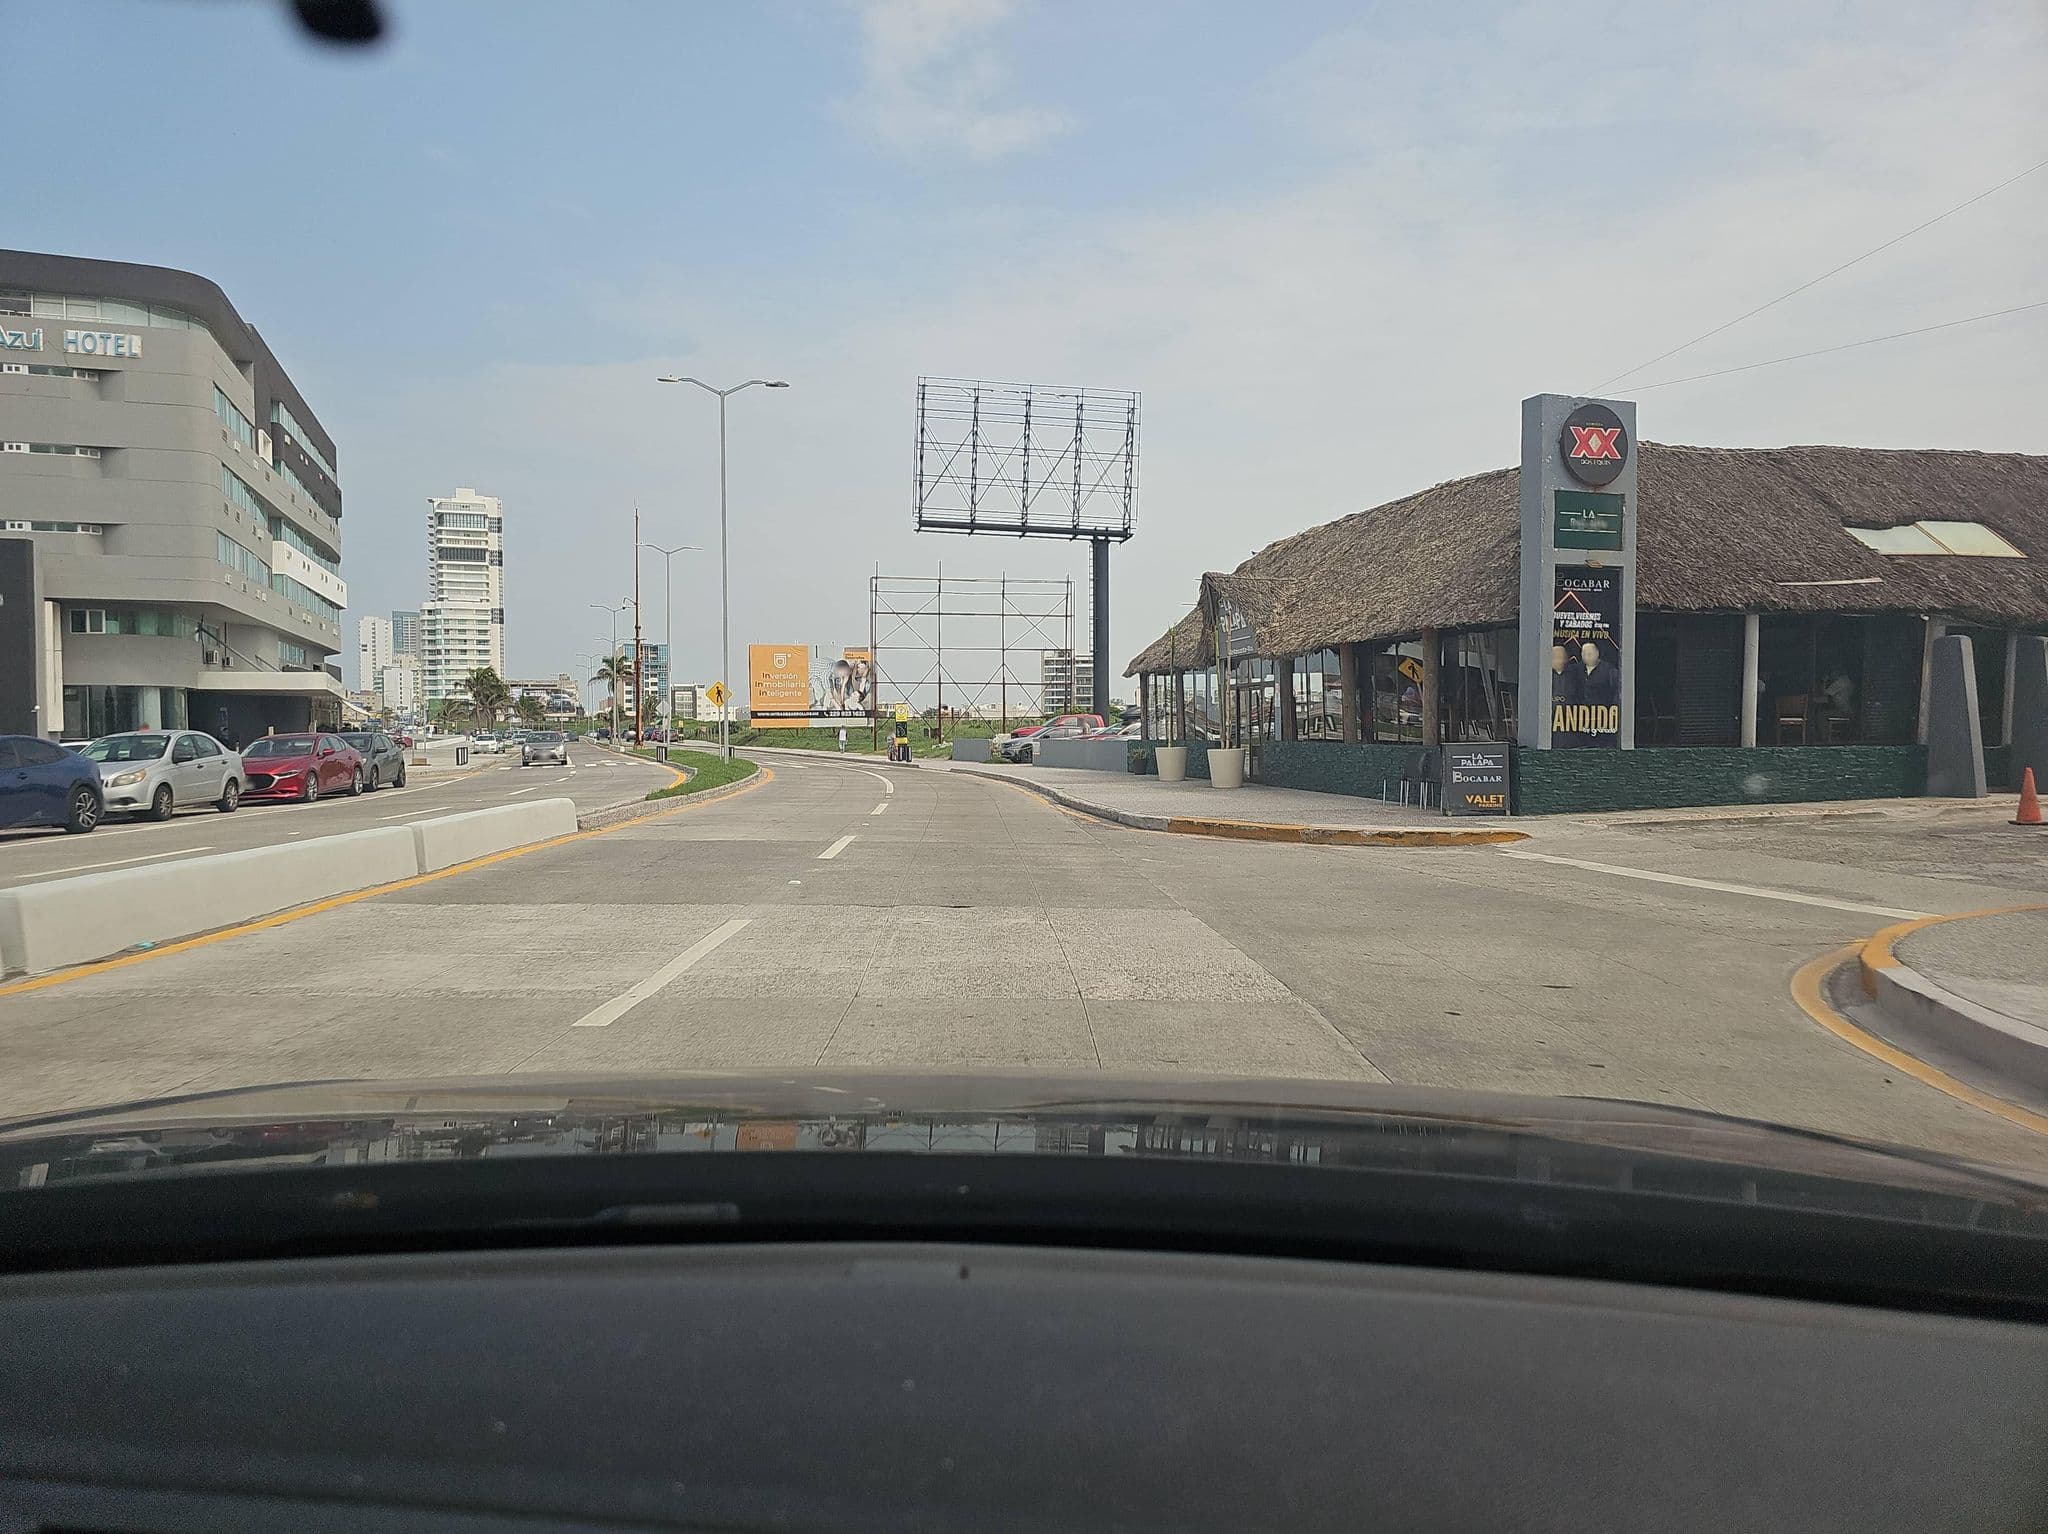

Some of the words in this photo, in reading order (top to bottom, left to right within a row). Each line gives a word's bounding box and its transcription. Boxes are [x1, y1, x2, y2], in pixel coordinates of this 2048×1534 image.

[64, 330, 142, 358] HOTEL
[1569, 426, 1622, 459] XX
[1583, 509, 1595, 519] LA
[762, 672, 799, 680] Inversión
[759, 689, 802, 698] Inteligente
[1465, 794, 1505, 804] VALET
